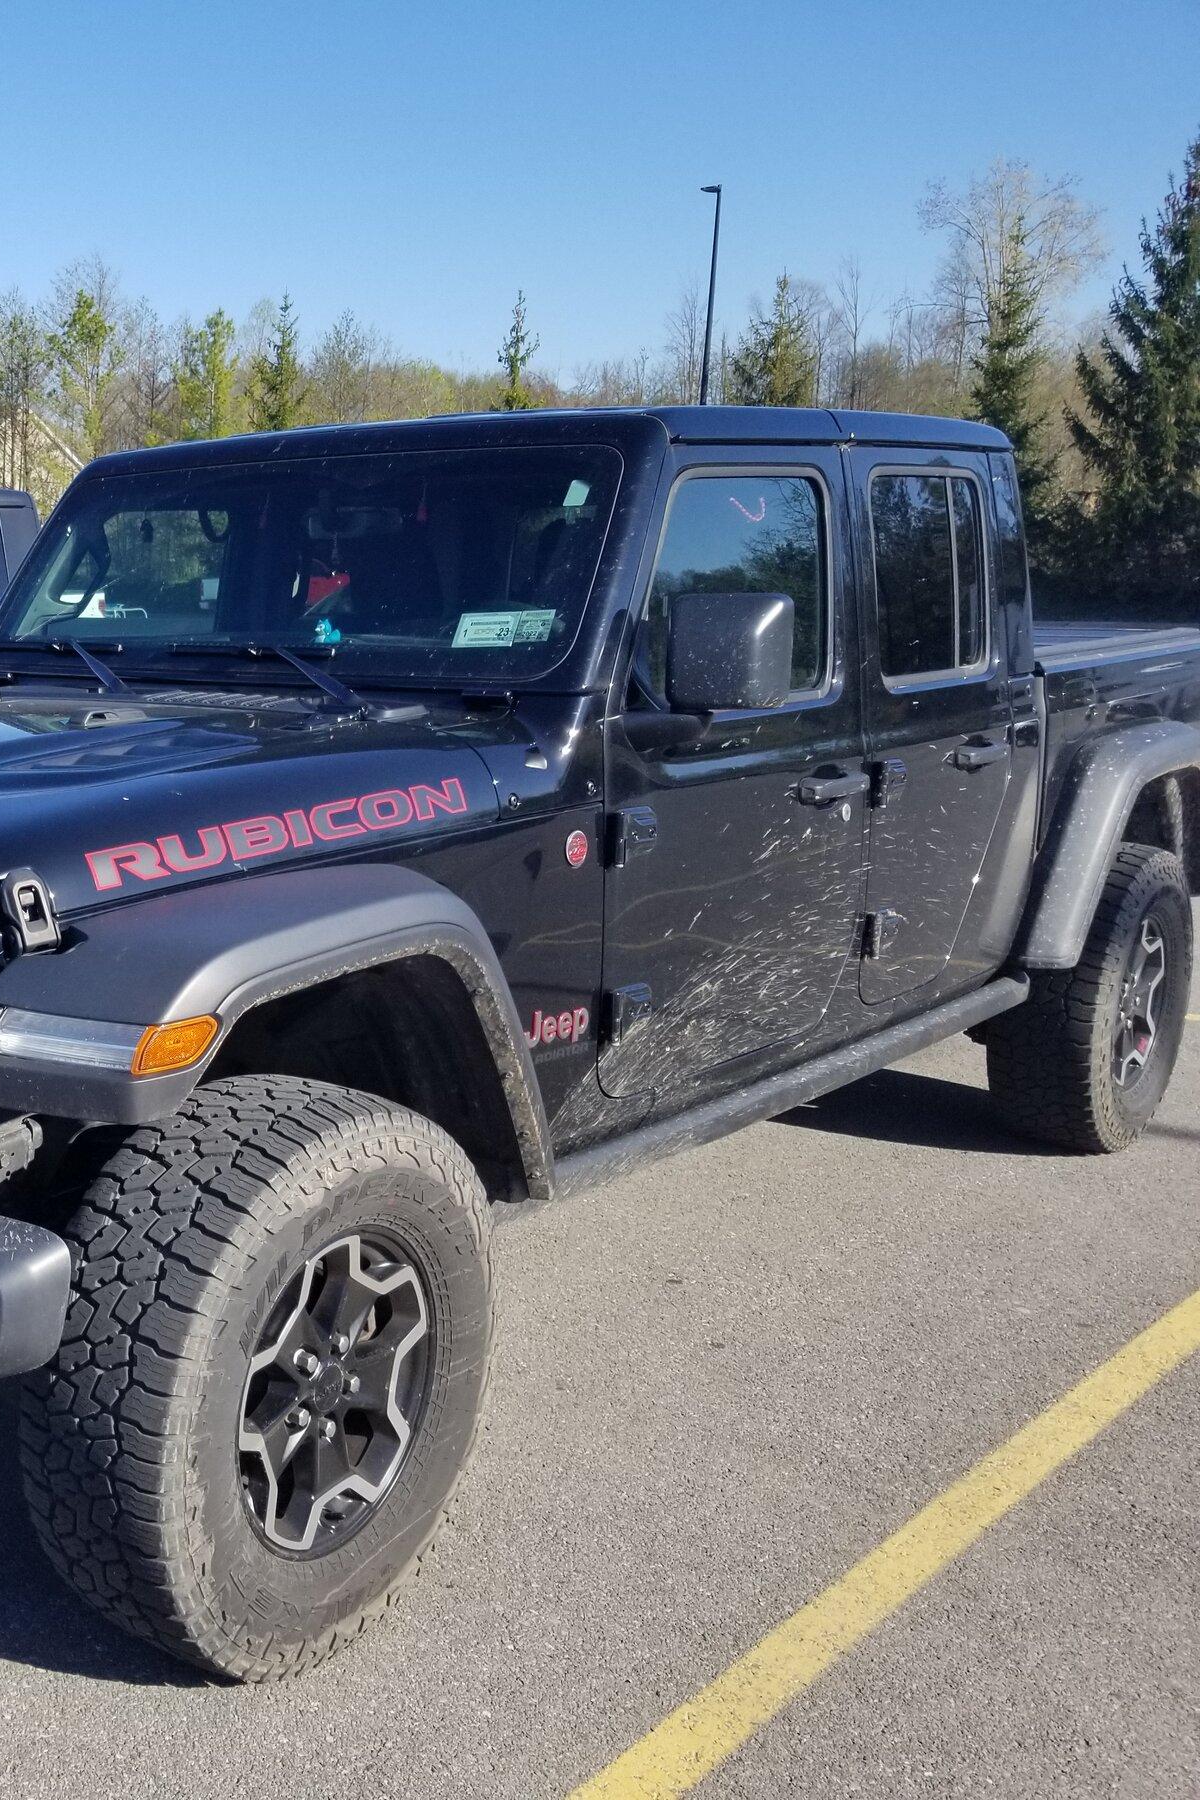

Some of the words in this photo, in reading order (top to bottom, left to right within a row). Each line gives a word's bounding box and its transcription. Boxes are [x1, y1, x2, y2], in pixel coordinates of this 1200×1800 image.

[497, 627, 510, 637] 23
[84, 778, 468, 892] RUBICON
[523, 1006, 590, 1049] Jeep
